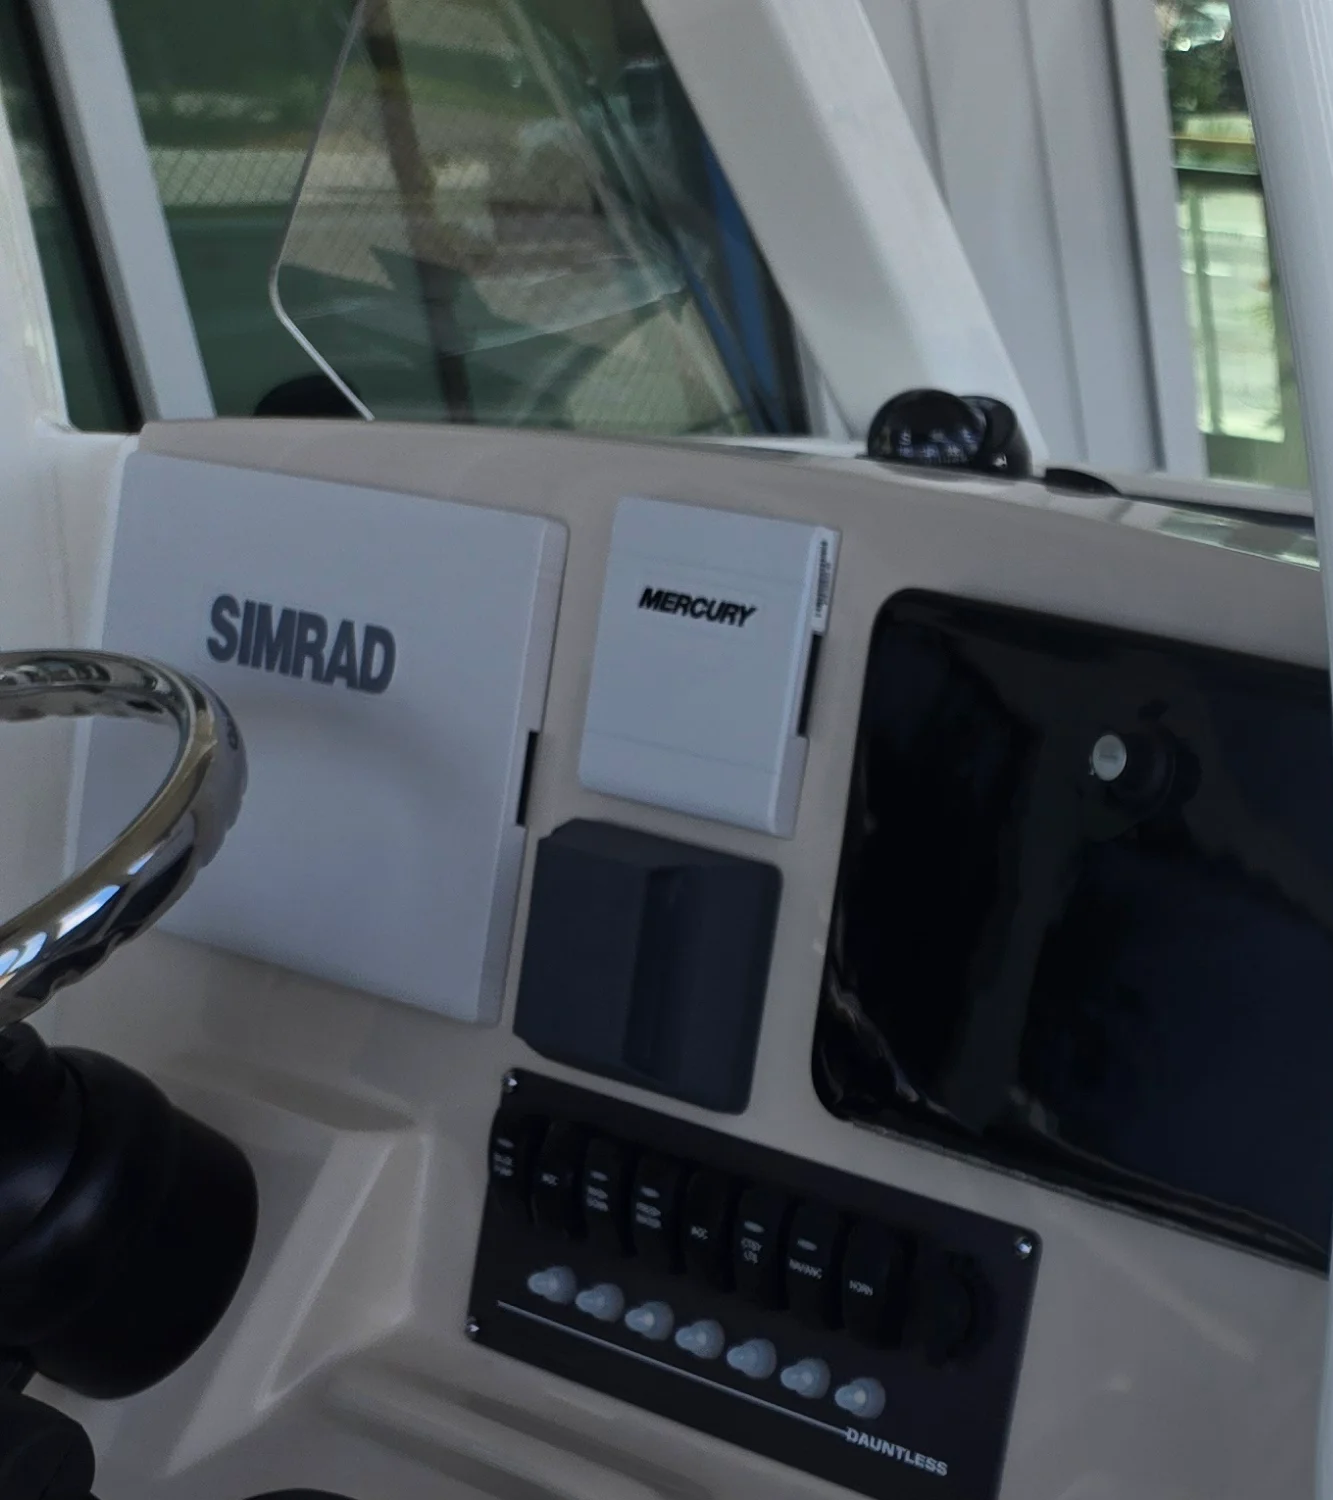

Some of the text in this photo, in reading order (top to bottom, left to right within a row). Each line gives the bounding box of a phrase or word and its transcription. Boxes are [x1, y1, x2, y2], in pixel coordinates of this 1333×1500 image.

[638, 586, 757, 628] MERCURY
[207, 594, 396, 694] SIMRAD
[845, 1426, 948, 1476] DAUNTLESS
